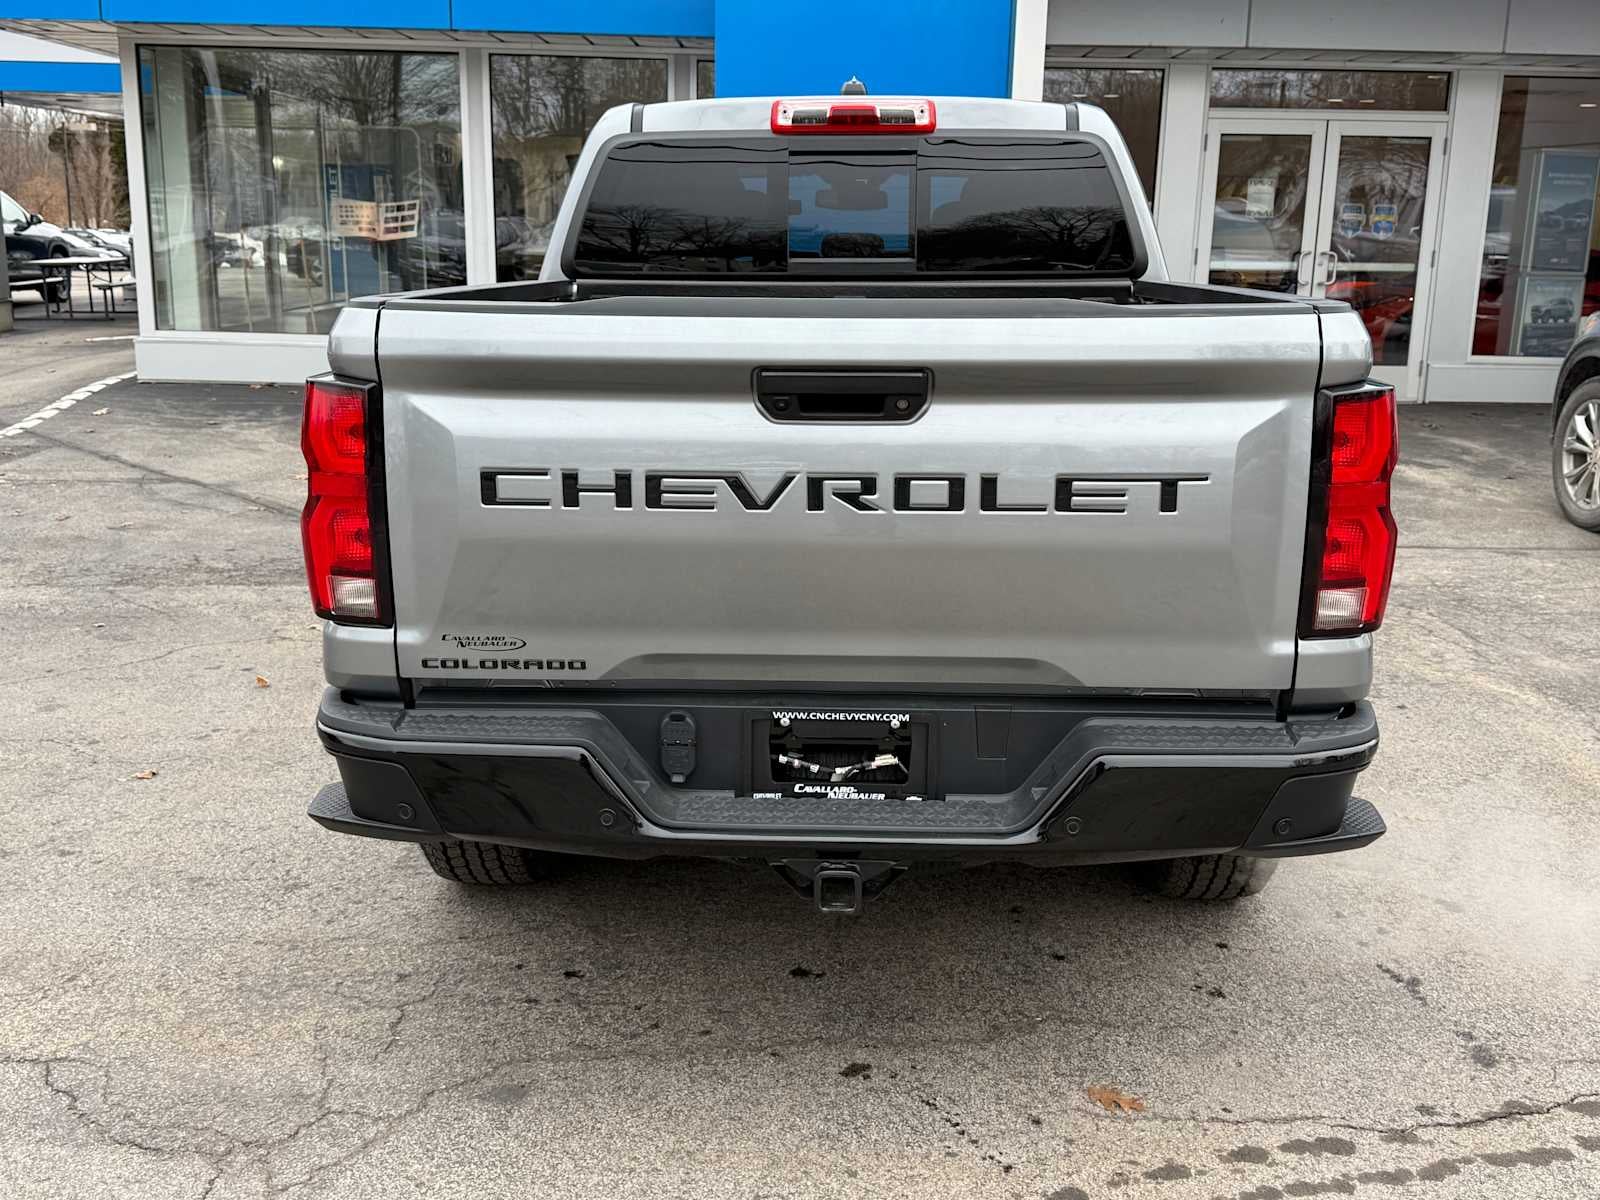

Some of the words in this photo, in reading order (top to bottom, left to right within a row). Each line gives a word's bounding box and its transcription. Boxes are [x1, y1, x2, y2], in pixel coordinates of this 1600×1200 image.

[480, 467, 1211, 515] CHEVROLET
[456, 640, 518, 648] NEUBAUER
[421, 658, 587, 670] COLORADO
[772, 711, 910, 722] WWW.CNCHEVYCNY.COM
[827, 791, 885, 800] NEUBAUER
